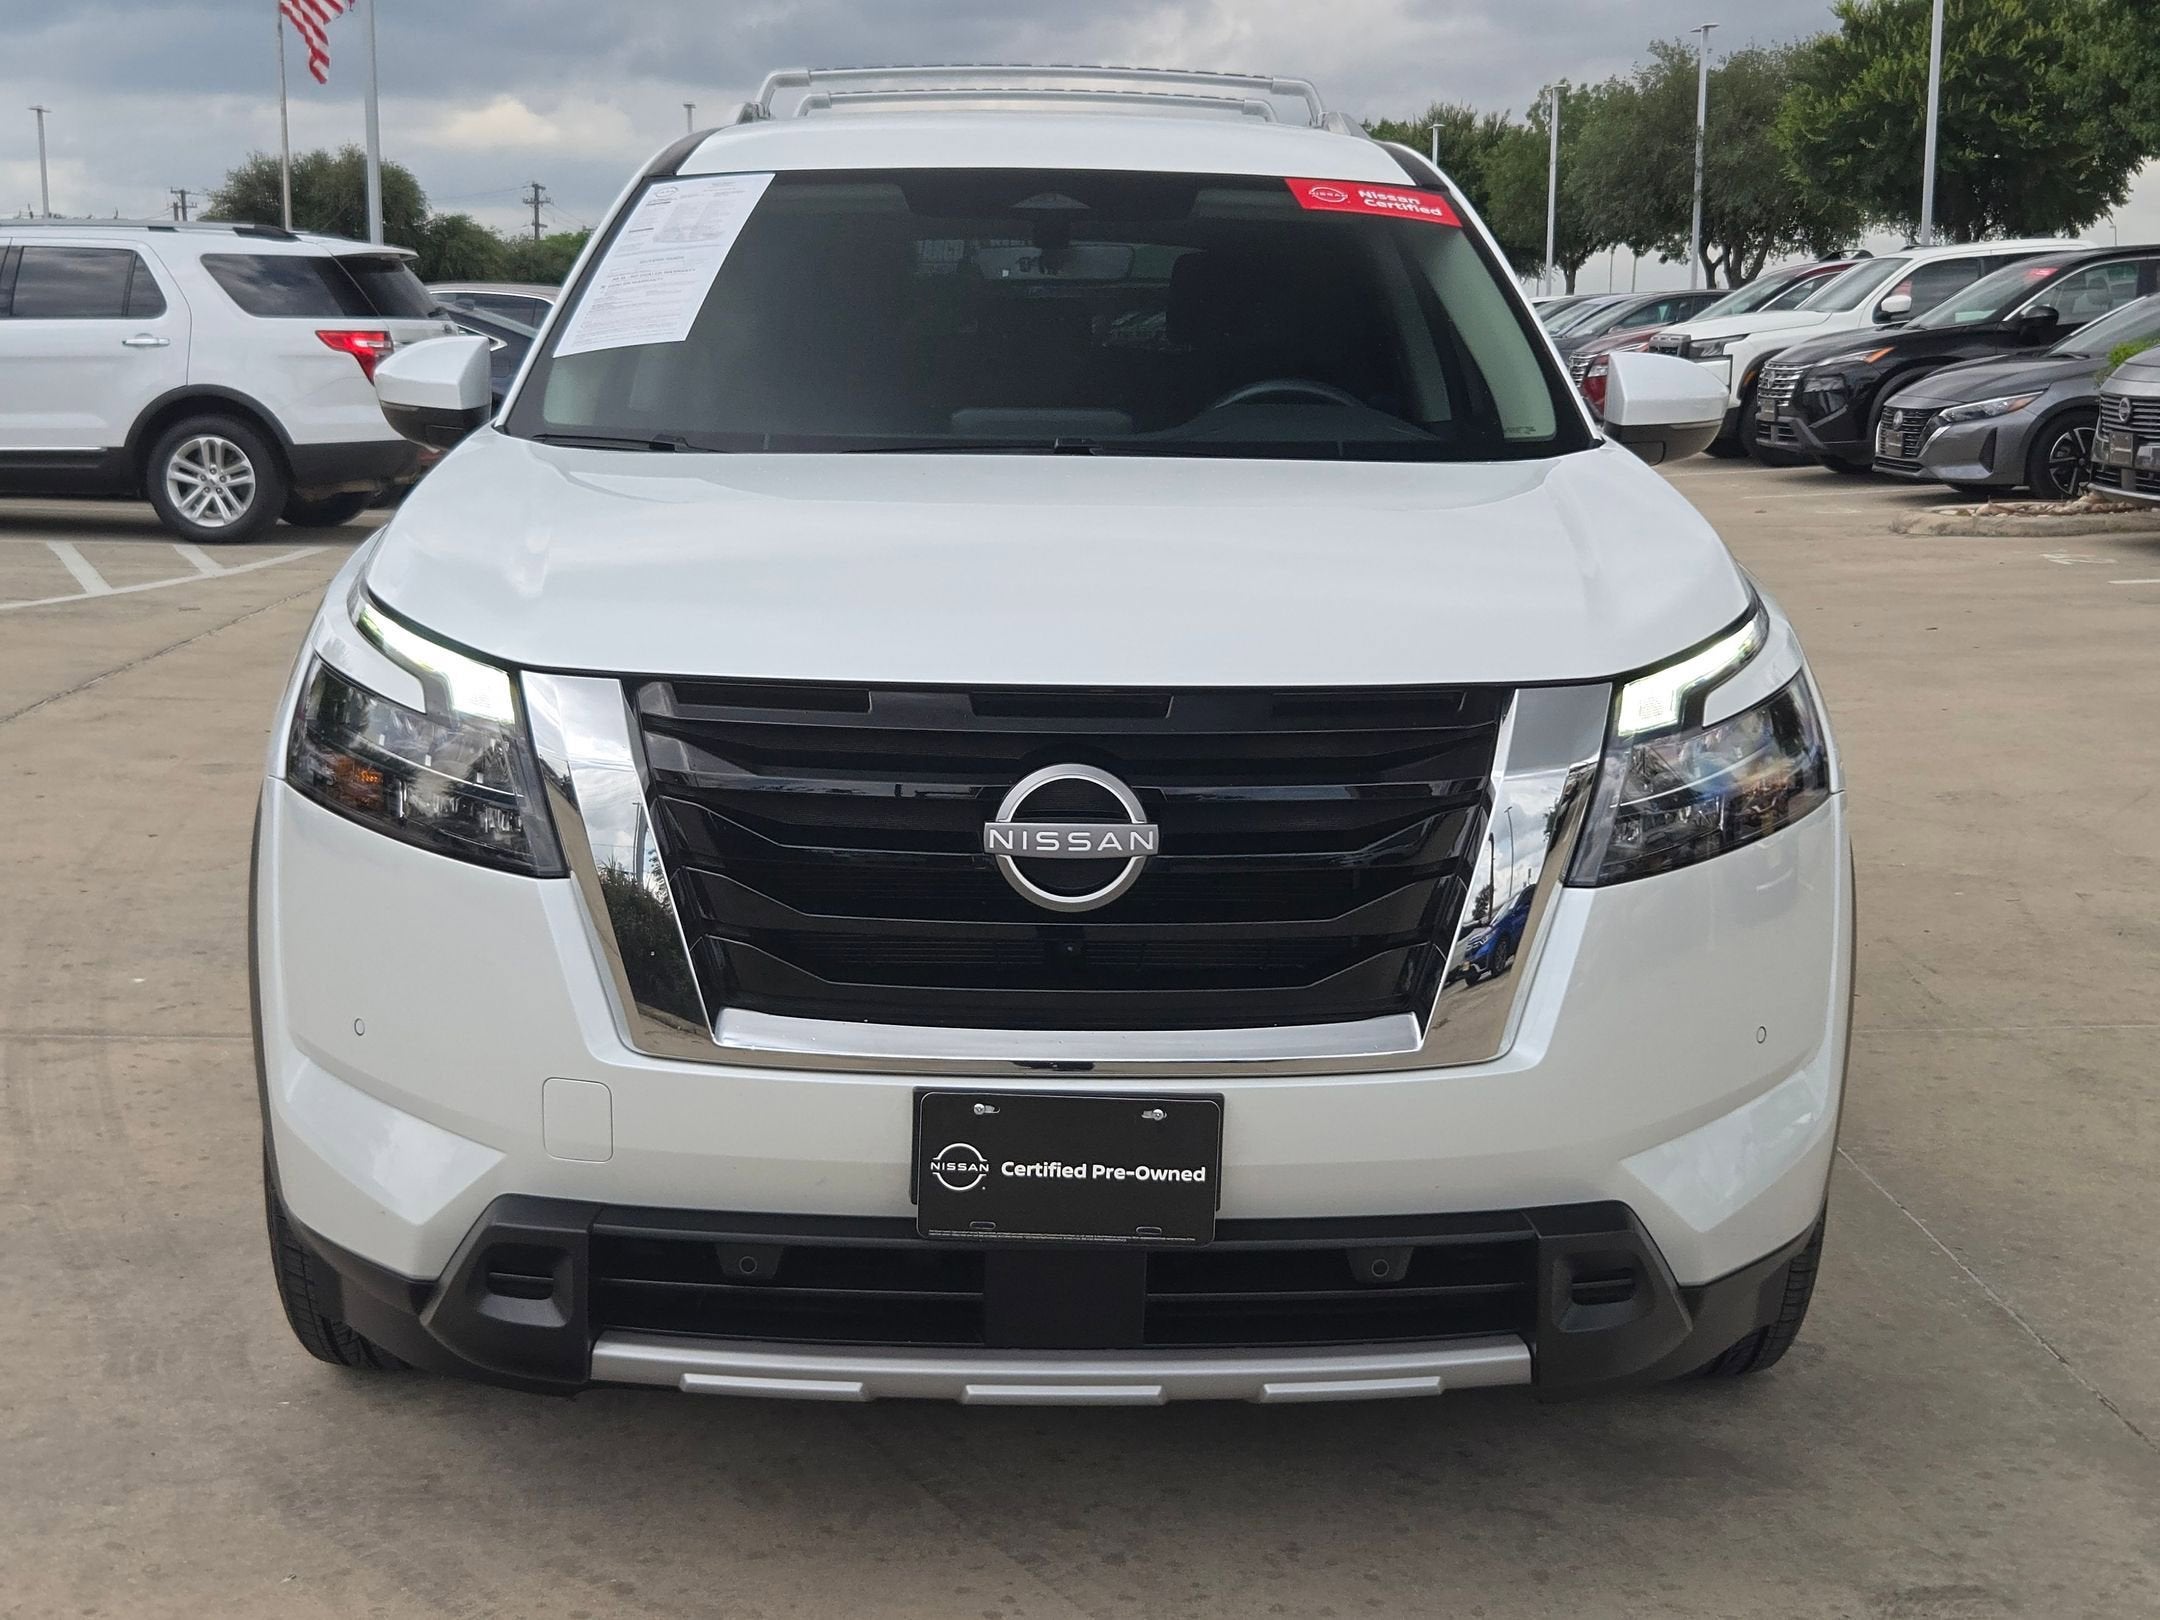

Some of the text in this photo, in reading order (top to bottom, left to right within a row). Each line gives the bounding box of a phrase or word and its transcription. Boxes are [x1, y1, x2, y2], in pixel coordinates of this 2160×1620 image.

[1358, 190, 1420, 204] Nissan
[1364, 198, 1442, 216] Certified
[989, 829, 1153, 851] NISSAN
[930, 1161, 989, 1173] NISSAN
[1000, 1161, 1206, 1182] Certified Pre-Owned
